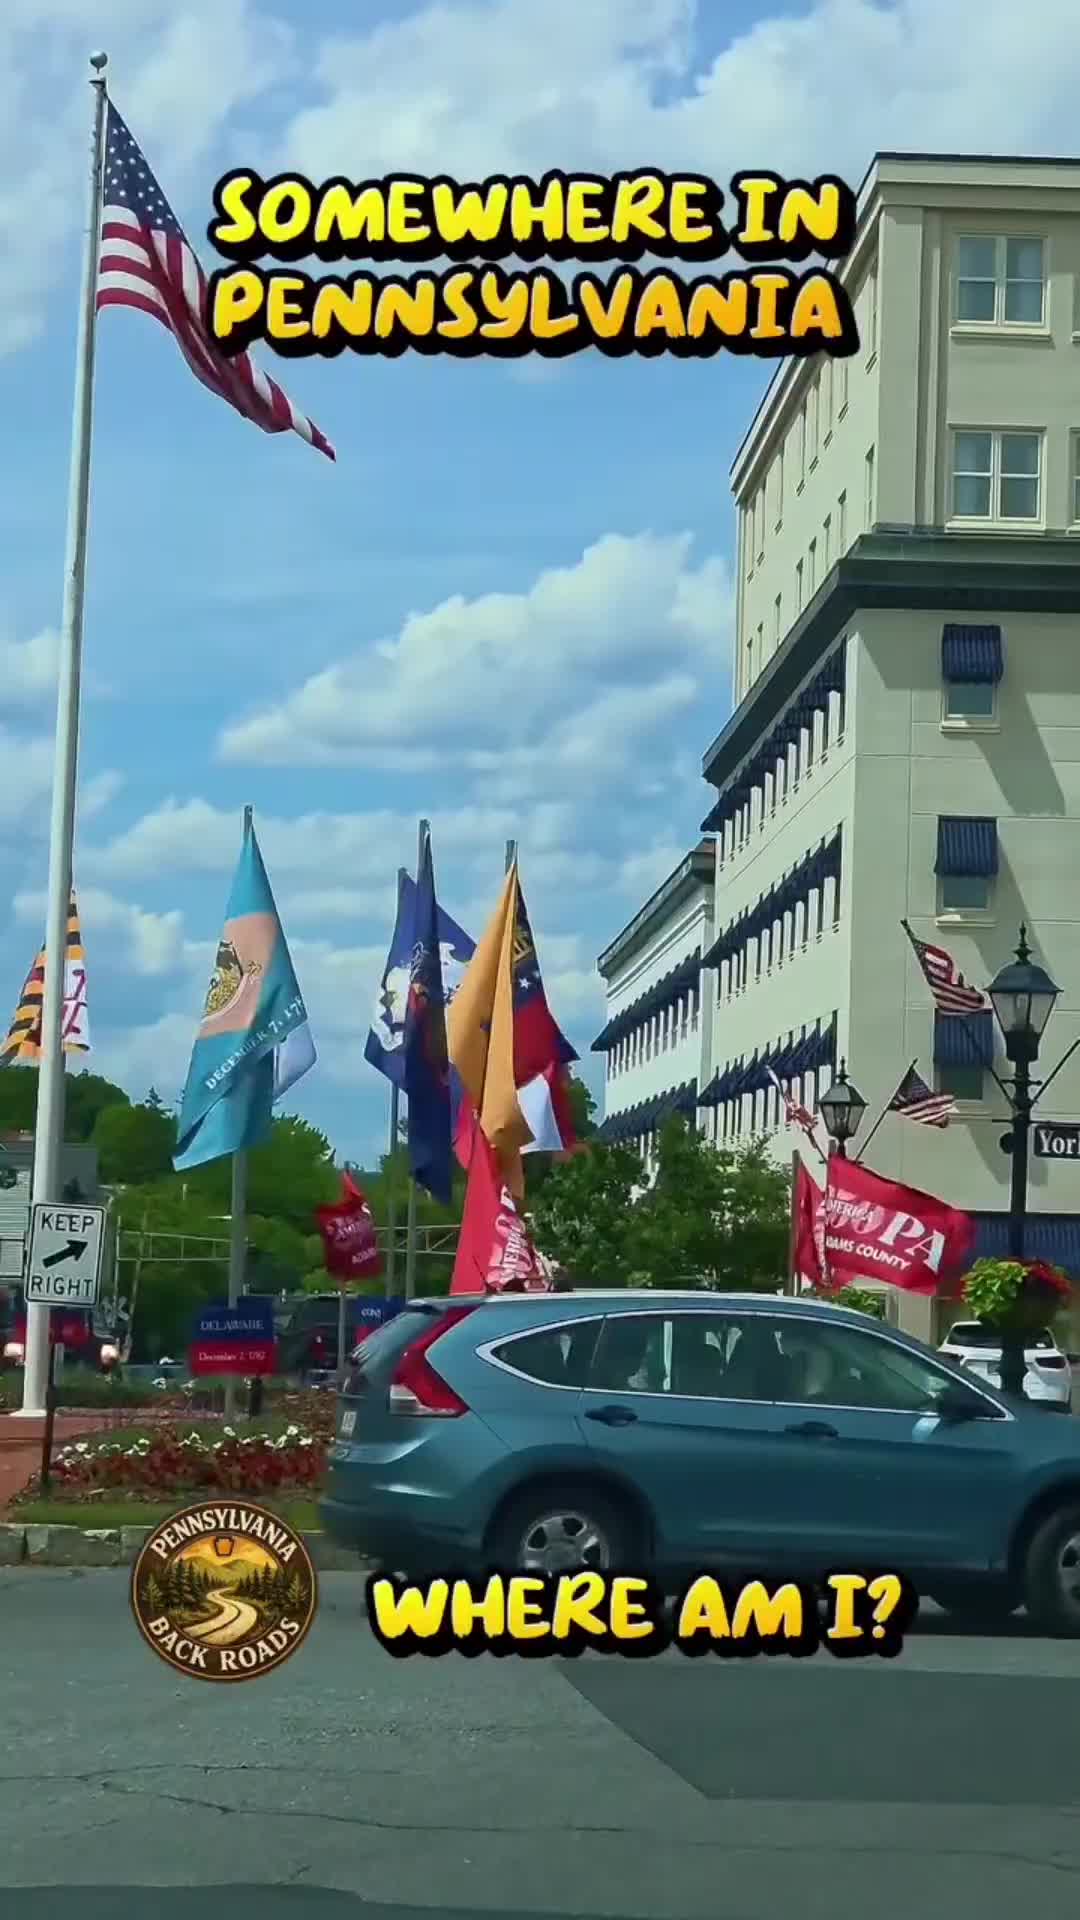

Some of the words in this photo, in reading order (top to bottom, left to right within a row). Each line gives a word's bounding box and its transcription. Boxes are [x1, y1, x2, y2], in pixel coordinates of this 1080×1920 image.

[41, 1211, 95, 1233] KEEP
[825, 1235, 855, 1253] DAMS
[855, 1243, 912, 1271] COUNTY
[878, 1211, 946, 1275] PA
[31, 1275, 94, 1297] RIGHT
[200, 1319, 265, 1331] DELAWARE
